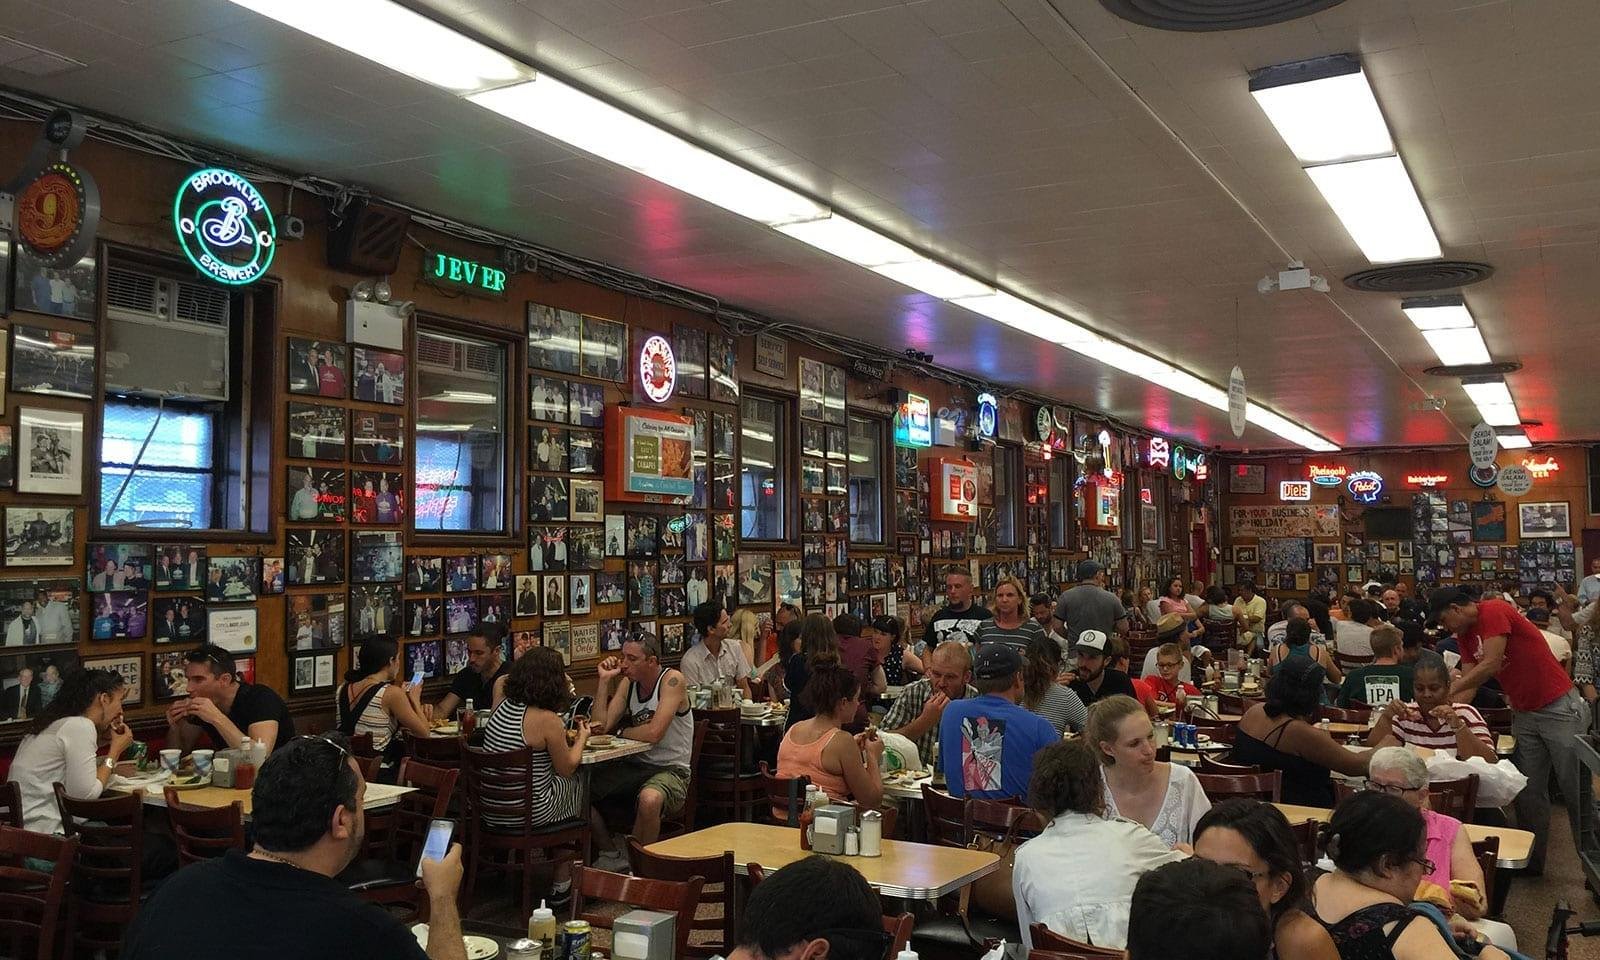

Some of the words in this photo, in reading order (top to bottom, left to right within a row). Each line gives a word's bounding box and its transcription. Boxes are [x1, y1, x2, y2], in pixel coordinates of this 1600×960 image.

[191, 172, 263, 212] BROOKLYN
[200, 254, 260, 280] BREWERY
[435, 254, 506, 291] JEVER
[1309, 464, 1346, 477] Rheingold
[1353, 480, 1377, 492] Pabst
[1233, 509, 1247, 519] FOR
[1271, 507, 1309, 518] BUSINESS
[1250, 518, 1283, 528] HOLIDAY
[1370, 688, 1394, 703] IPA
